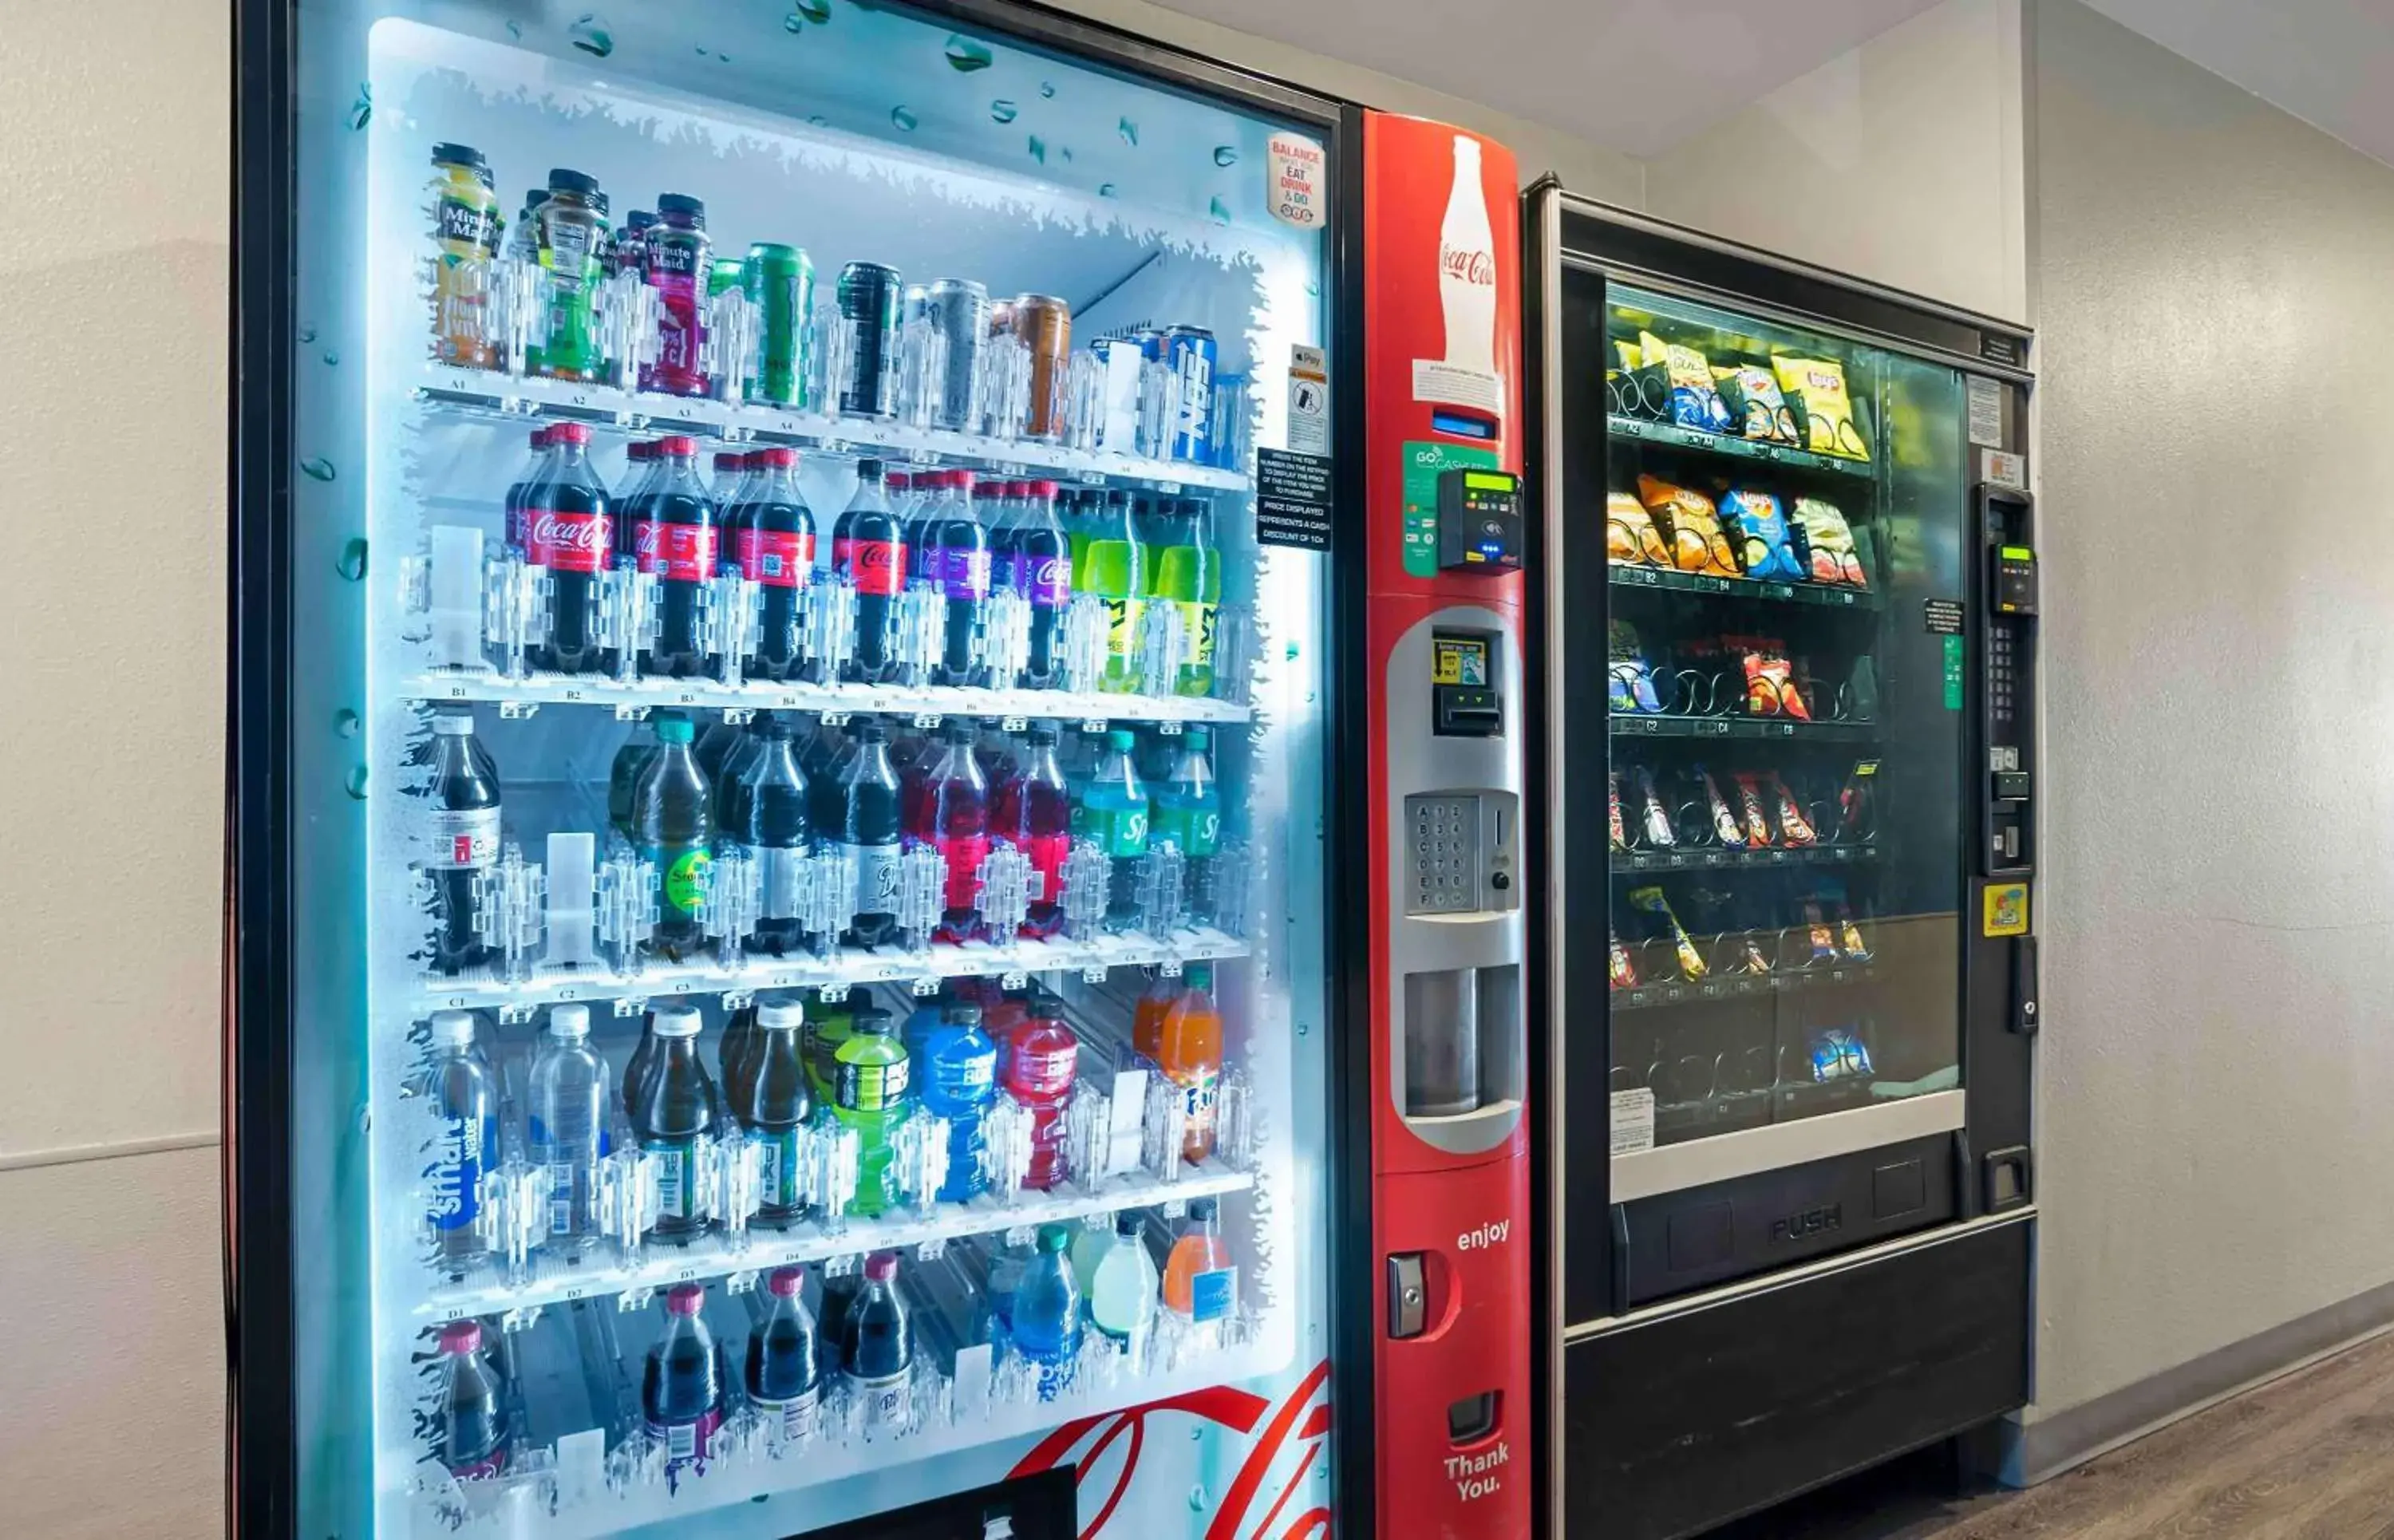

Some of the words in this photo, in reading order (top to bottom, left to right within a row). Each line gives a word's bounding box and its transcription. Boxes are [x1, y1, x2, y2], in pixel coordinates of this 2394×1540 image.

[1286, 166, 1305, 180] EAT
[1281, 176, 1312, 195] DRINK
[649, 242, 691, 260] Minute
[652, 255, 685, 270] Maid
[452, 687, 465, 697] B1
[567, 689, 581, 700] B2
[449, 997, 464, 1006] C1
[559, 990, 575, 999] C2
[1768, 1202, 1841, 1243] PUSH
[1458, 1218, 1509, 1250] enjoy
[567, 1289, 582, 1298] D2
[448, 1309, 464, 1319] D1
[1444, 1442, 1509, 1480] Thank
[1456, 1476, 1500, 1502] You.
